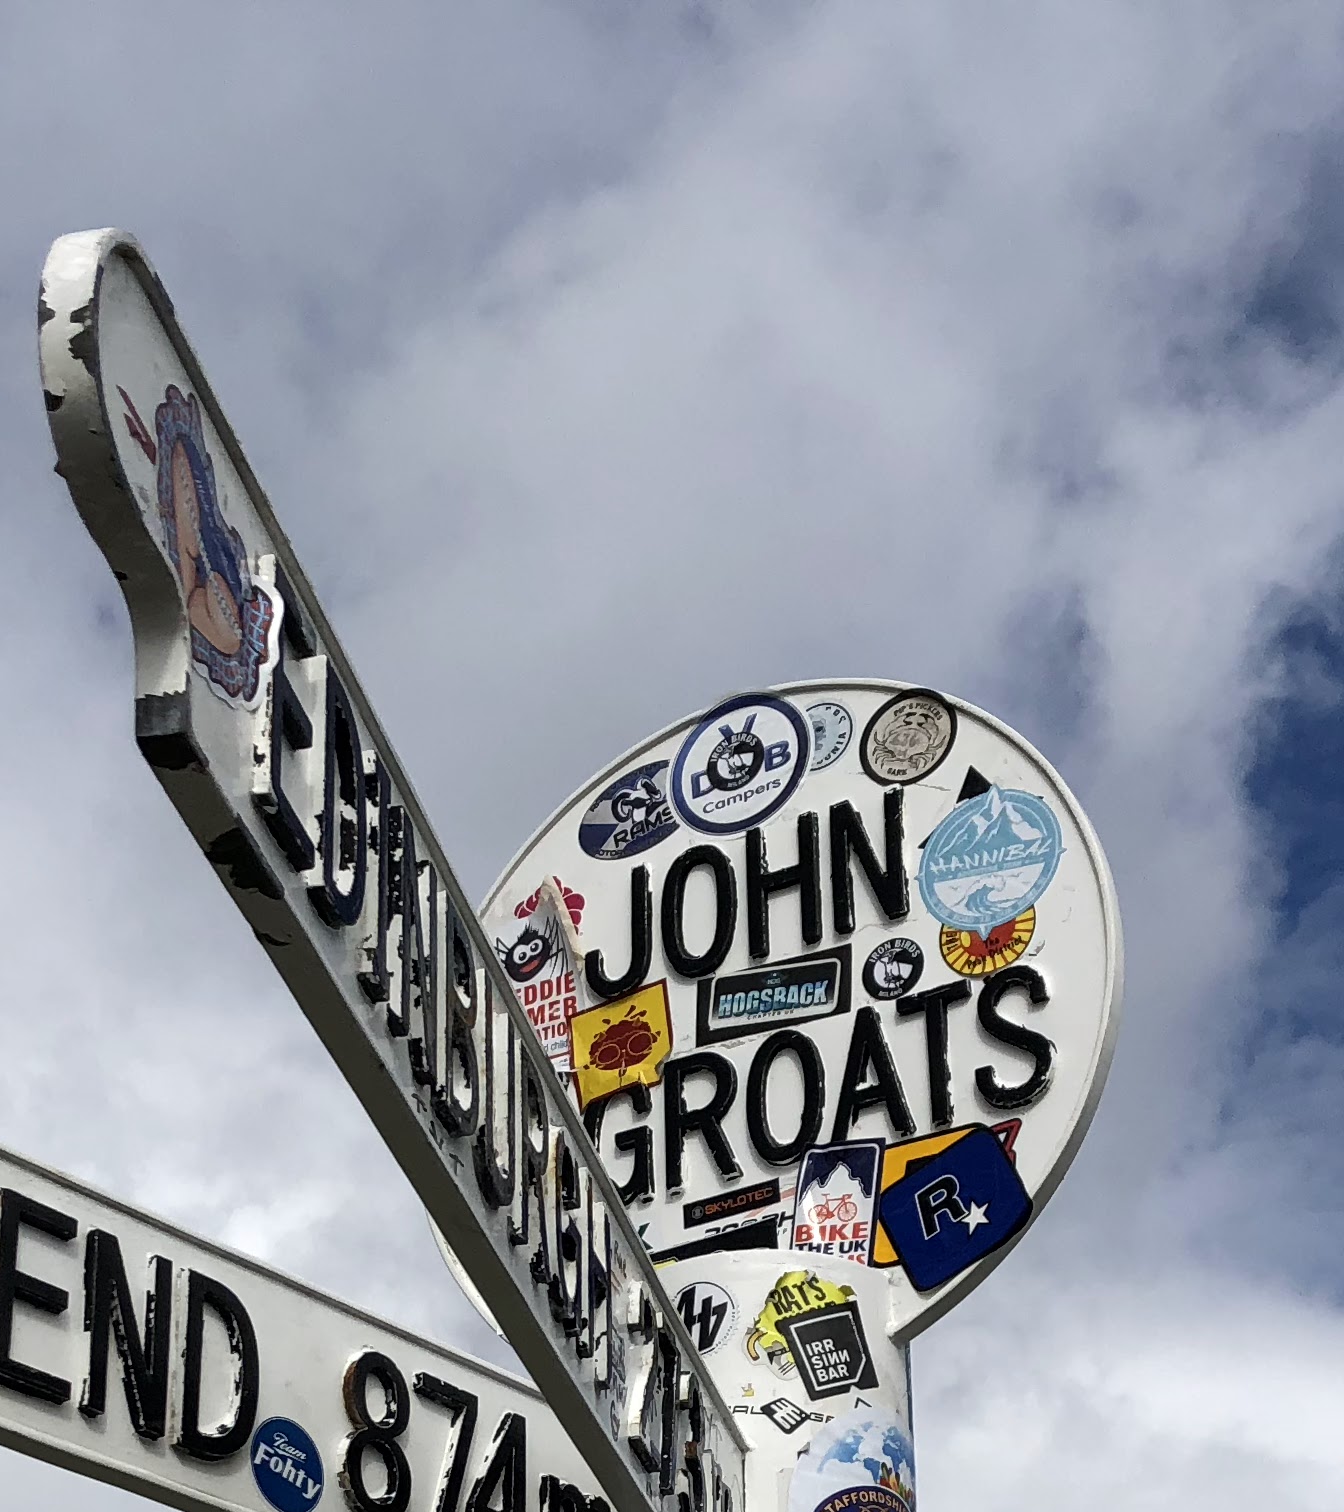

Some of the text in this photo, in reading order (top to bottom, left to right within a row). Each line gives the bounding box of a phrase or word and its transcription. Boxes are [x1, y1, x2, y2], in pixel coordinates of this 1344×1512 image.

[710, 733, 757, 763] IRON BIRDS
[702, 778, 781, 813] Campers
[929, 836, 1053, 874] HANNIBAL
[584, 785, 911, 999] JOHN
[868, 939, 892, 963] IRON
[895, 939, 921, 959] BIRDS
[252, 553, 612, 1392] EDINBURGH
[717, 980, 829, 1019] HOGSBACK
[581, 964, 1052, 1210] GROATS
[704, 1186, 774, 1215] SKYLOTEC
[917, 1173, 962, 1241] R
[795, 1221, 870, 1244] BIKE
[797, 1239, 867, 1256] THE UK
[771, 1276, 827, 1316] RATS
[806, 1338, 836, 1356] IRR
[816, 1363, 850, 1382] BAR
[273, 1432, 307, 1460] Team
[254, 1441, 321, 1500] Fohty
